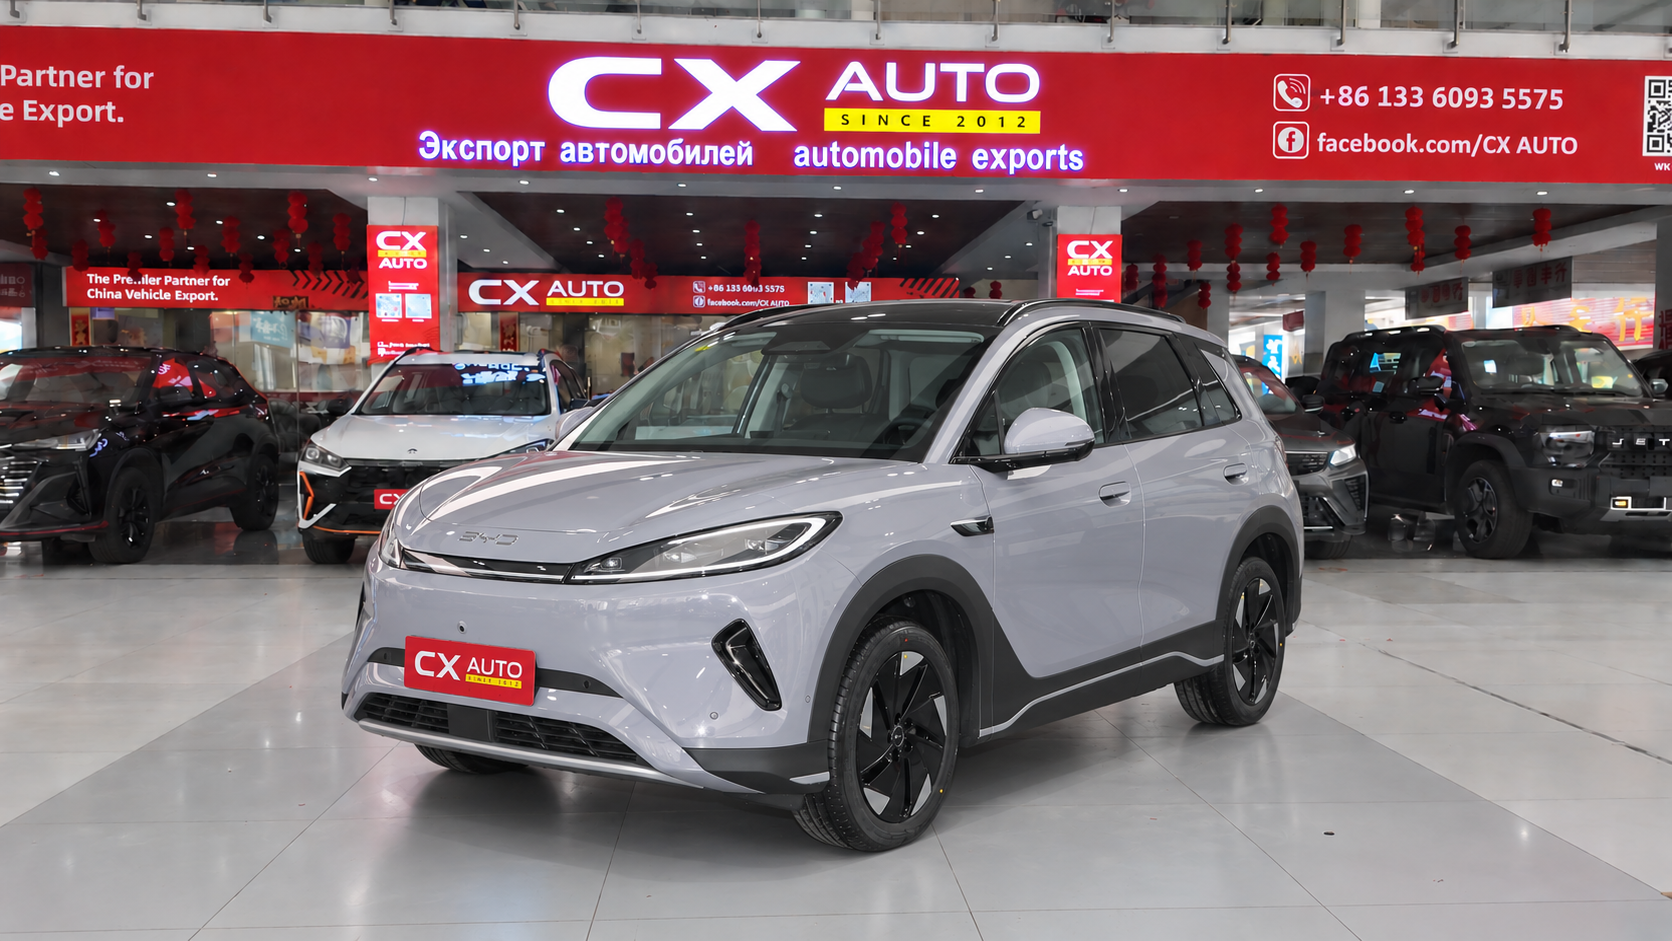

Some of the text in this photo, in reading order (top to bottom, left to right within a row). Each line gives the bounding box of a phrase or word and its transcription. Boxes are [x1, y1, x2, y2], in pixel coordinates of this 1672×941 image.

[0, 64, 155, 89] Partner for
[826, 61, 1040, 103] AUTO
[549, 56, 801, 132] CX
[1320, 85, 1563, 110] +86 133 6093 5575
[23, 99, 124, 128] Export.
[841, 113, 1026, 128] SINCE 2012
[419, 131, 753, 167] Экспорт автомобилей
[1317, 133, 1578, 158] facebook.com/CX AUTO
[793, 141, 1084, 175] automobile exports
[375, 230, 427, 251] CX
[1066, 240, 1113, 259] CX
[378, 257, 428, 270] AUTO
[1067, 264, 1113, 276] AUTO
[86, 273, 110, 285] The
[164, 275, 210, 287] Partner
[212, 275, 231, 287] for
[547, 280, 625, 298] AUTO
[707, 284, 724, 293] +86
[86, 288, 219, 304] China Vehicle Export.
[468, 279, 540, 306] CX
[458, 530, 519, 546] BYD
[414, 650, 461, 681] CX
[466, 657, 523, 679] AUTO
